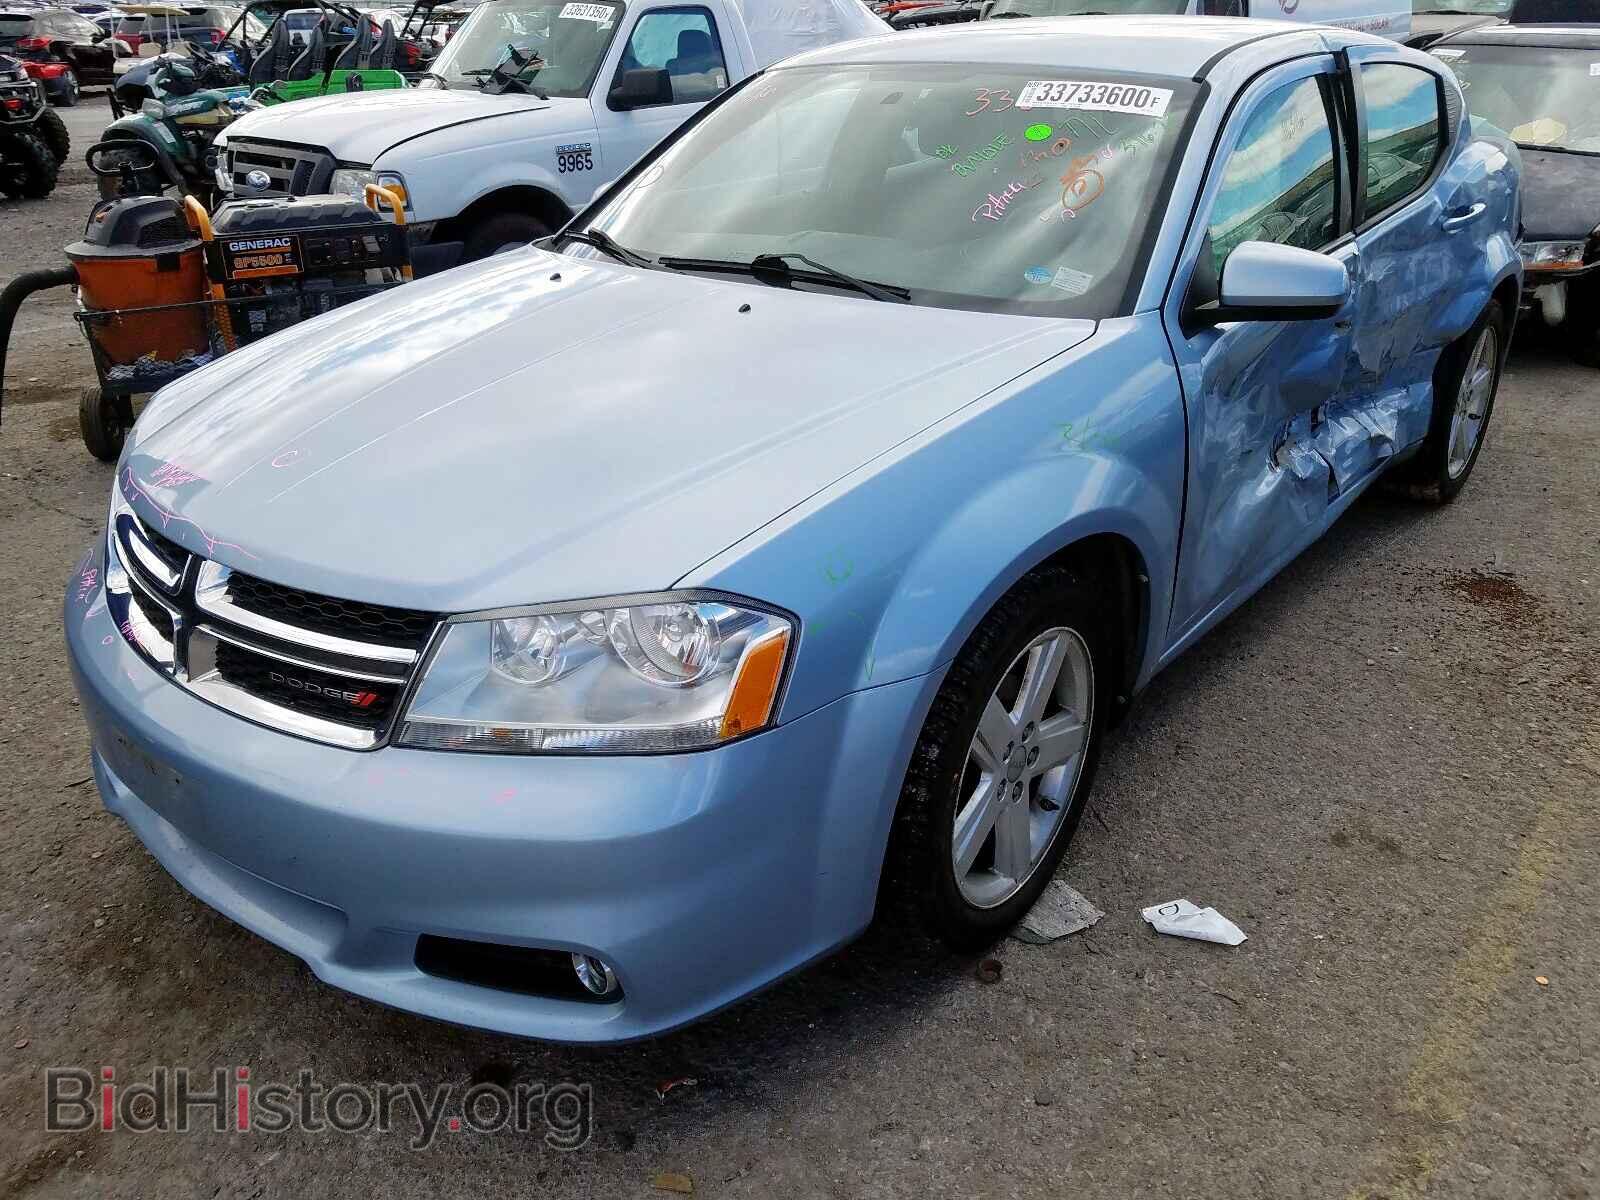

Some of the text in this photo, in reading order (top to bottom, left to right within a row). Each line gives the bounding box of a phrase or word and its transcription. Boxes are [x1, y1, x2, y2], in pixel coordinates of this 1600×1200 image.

[1036, 82, 1152, 108] 33733600
[558, 153, 593, 173] 9965
[229, 237, 291, 252] GENERAC
[233, 253, 283, 269] GP5500
[270, 671, 361, 704] DODGE
